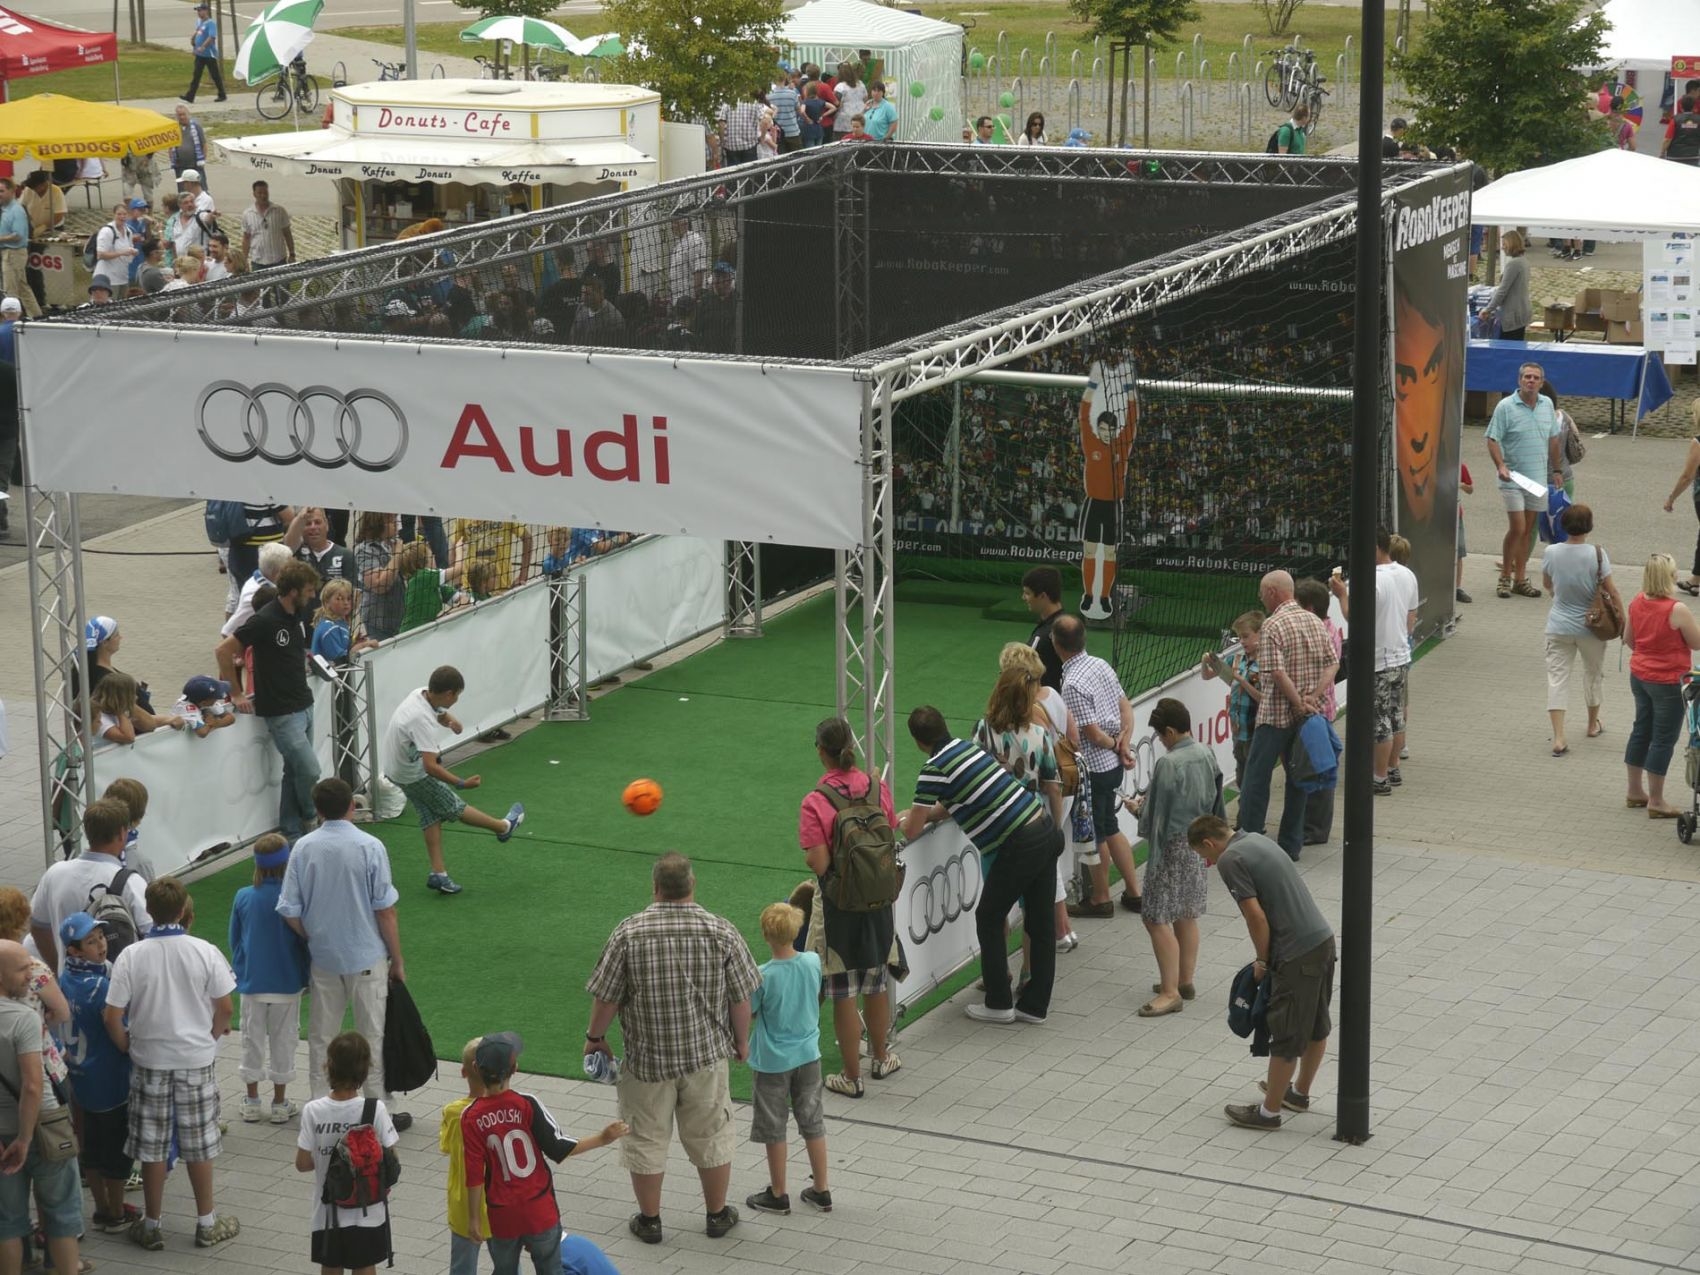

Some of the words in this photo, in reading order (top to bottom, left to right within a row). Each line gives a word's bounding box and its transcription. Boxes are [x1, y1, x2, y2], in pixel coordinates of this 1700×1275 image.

[378, 108, 447, 128] Donuts
[464, 111, 511, 137] Cafe
[38, 141, 122, 156] HOTDOGS
[135, 129, 180, 151] HOTDOGS
[305, 163, 342, 175] Donuts
[361, 165, 396, 178] Kaffee
[415, 167, 452, 179] Donuts
[501, 170, 541, 182] Kaffee
[596, 168, 638, 180] Donuts
[30, 253, 63, 272] OGS
[1289, 279, 1358, 293] www.Robo
[440, 403, 670, 484] Audi
[892, 537, 942, 552] eper.com
[979, 544, 1083, 561] www.RoboKeepe
[476, 1108, 523, 1132] PODOLSKI
[486, 1129, 537, 1183] 10
